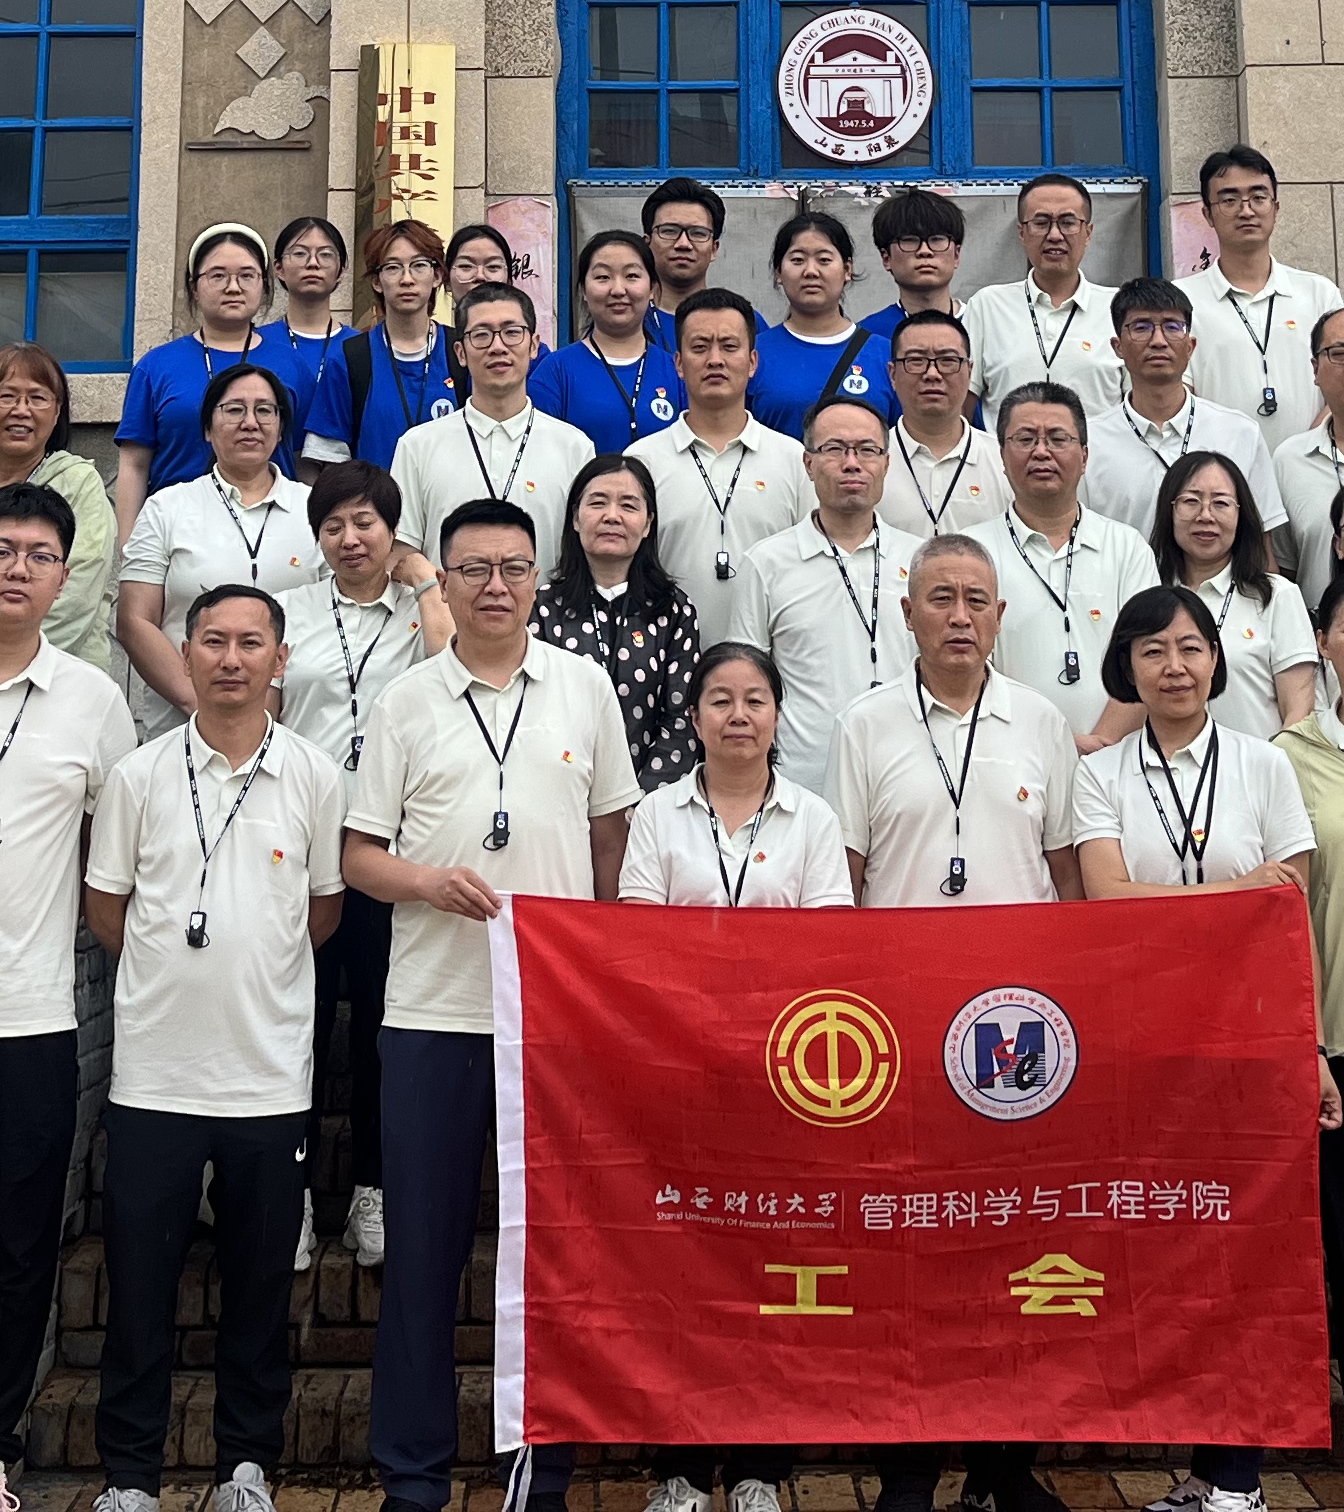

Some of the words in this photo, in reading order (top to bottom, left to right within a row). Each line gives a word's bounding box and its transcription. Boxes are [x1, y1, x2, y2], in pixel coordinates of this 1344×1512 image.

[785, 59, 798, 98] ZHONG
[793, 29, 819, 56] GONG
[820, 15, 866, 32] CHUANG
[869, 17, 895, 34] JIAN
[894, 32, 908, 46] DI
[906, 45, 918, 58] YI
[914, 60, 927, 99] CHENG
[838, 119, 875, 128] 1947.5.4
[1010, 1102, 1037, 1114] Science
[655, 1184, 837, 1217] 山西财经大学
[860, 1180, 1231, 1231] 管理科学与工程学院
[684, 1212, 725, 1227] University
[727, 1217, 738, 1226] Of
[739, 1219, 771, 1229] Finance
[772, 1220, 790, 1229] And
[791, 1220, 835, 1229] Economics
